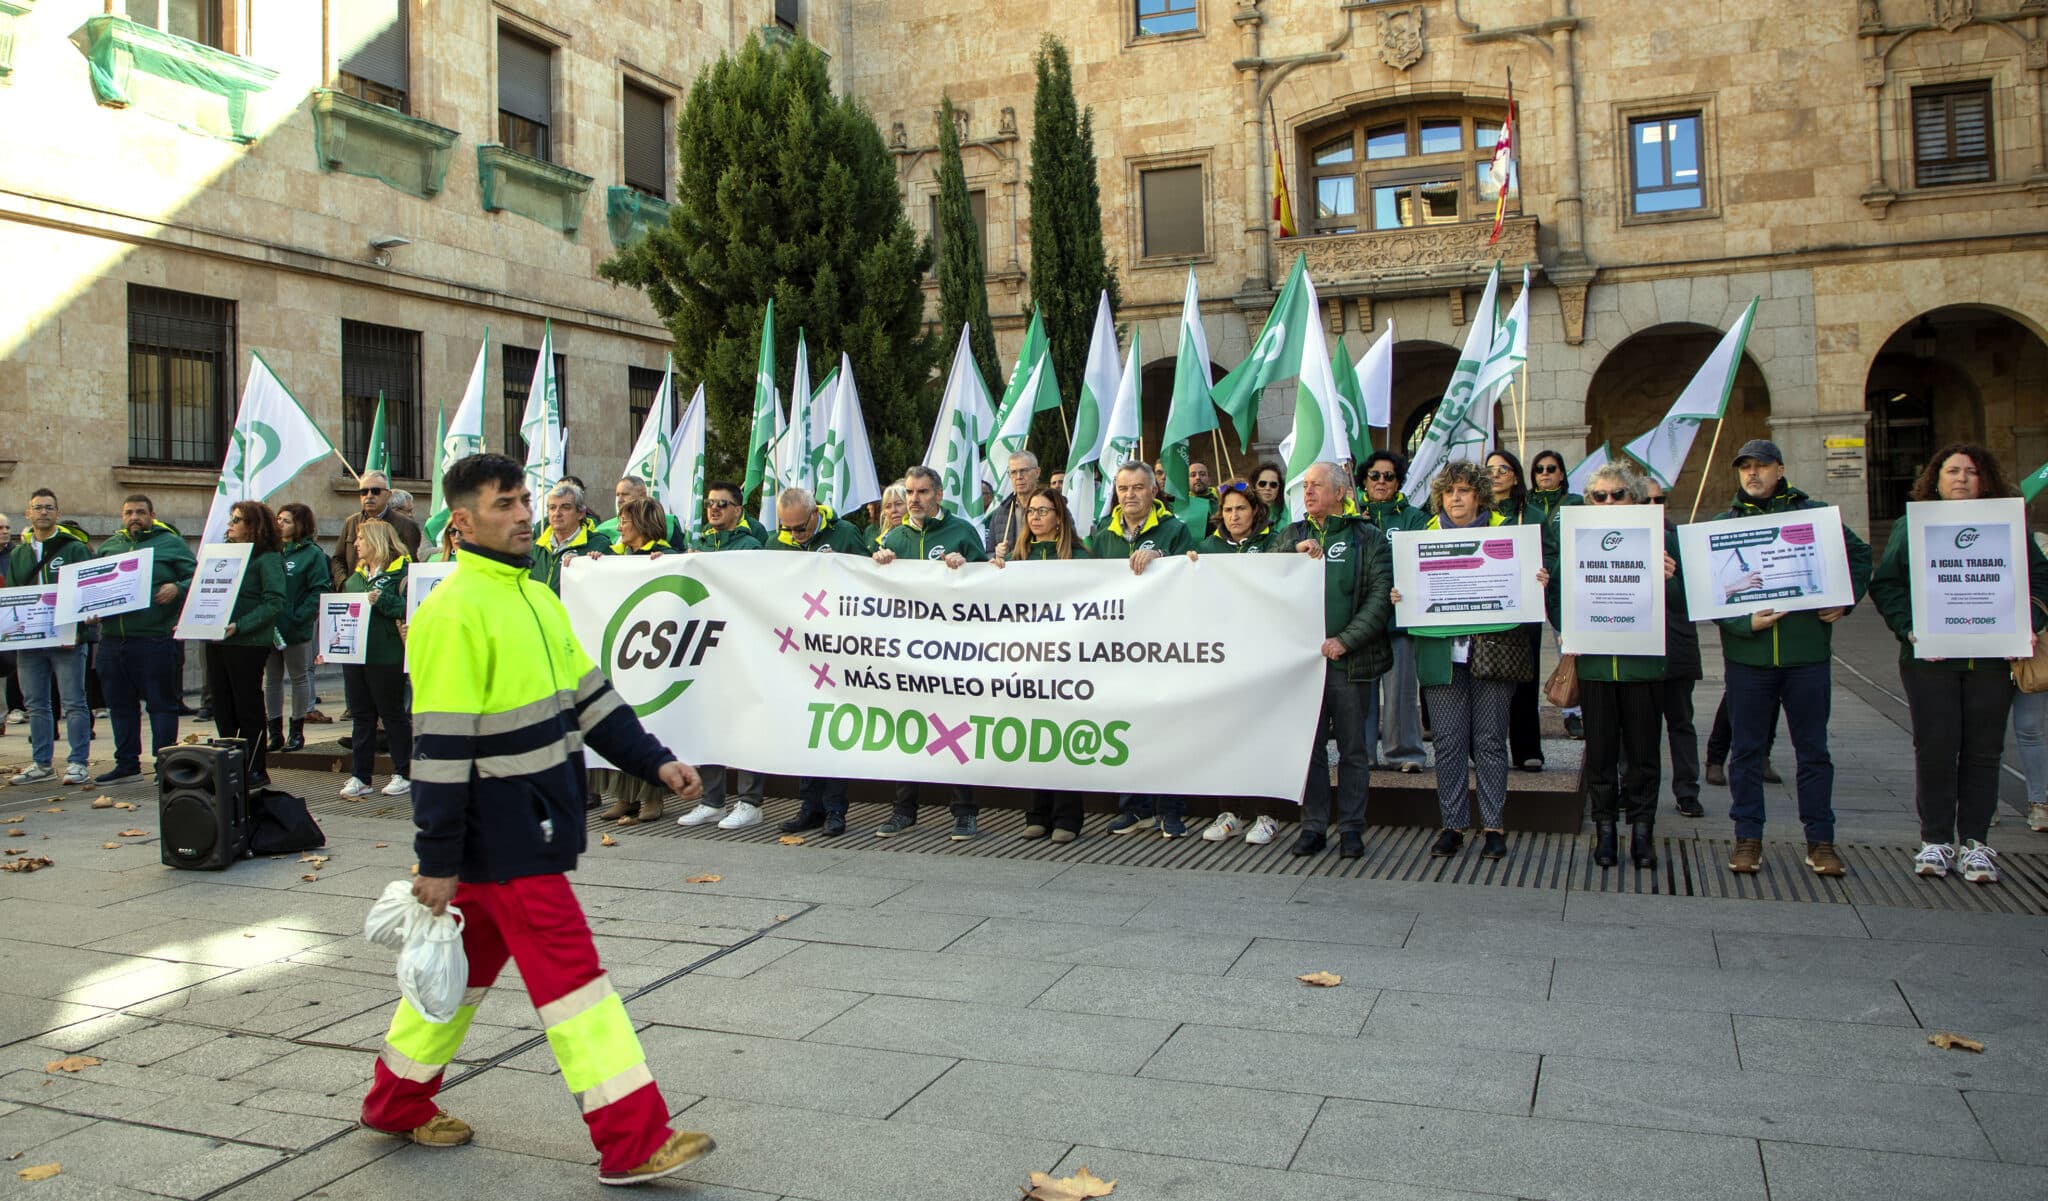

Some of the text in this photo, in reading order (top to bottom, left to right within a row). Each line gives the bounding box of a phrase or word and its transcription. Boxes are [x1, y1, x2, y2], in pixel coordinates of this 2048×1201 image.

[1605, 536, 1624, 544] CSIF
[1960, 534, 1980, 542] CSIF
[1580, 560, 1646, 570] A IGUAL TRABAJO,
[1931, 558, 2006, 568] A IGUAL TRABAJO,
[1585, 575, 1641, 583] IGUAL SALARIO
[1938, 574, 2000, 583] IGUAL SALARIO
[952, 602, 1066, 623] SALARIAL
[1072, 599, 1125, 621] YA!!!
[617, 619, 727, 670] CSIF
[804, 632, 1226, 664] MEJORES CONDICIONES LABORALES
[844, 665, 1094, 701] MÁS EMPLEO PÚBLICO
